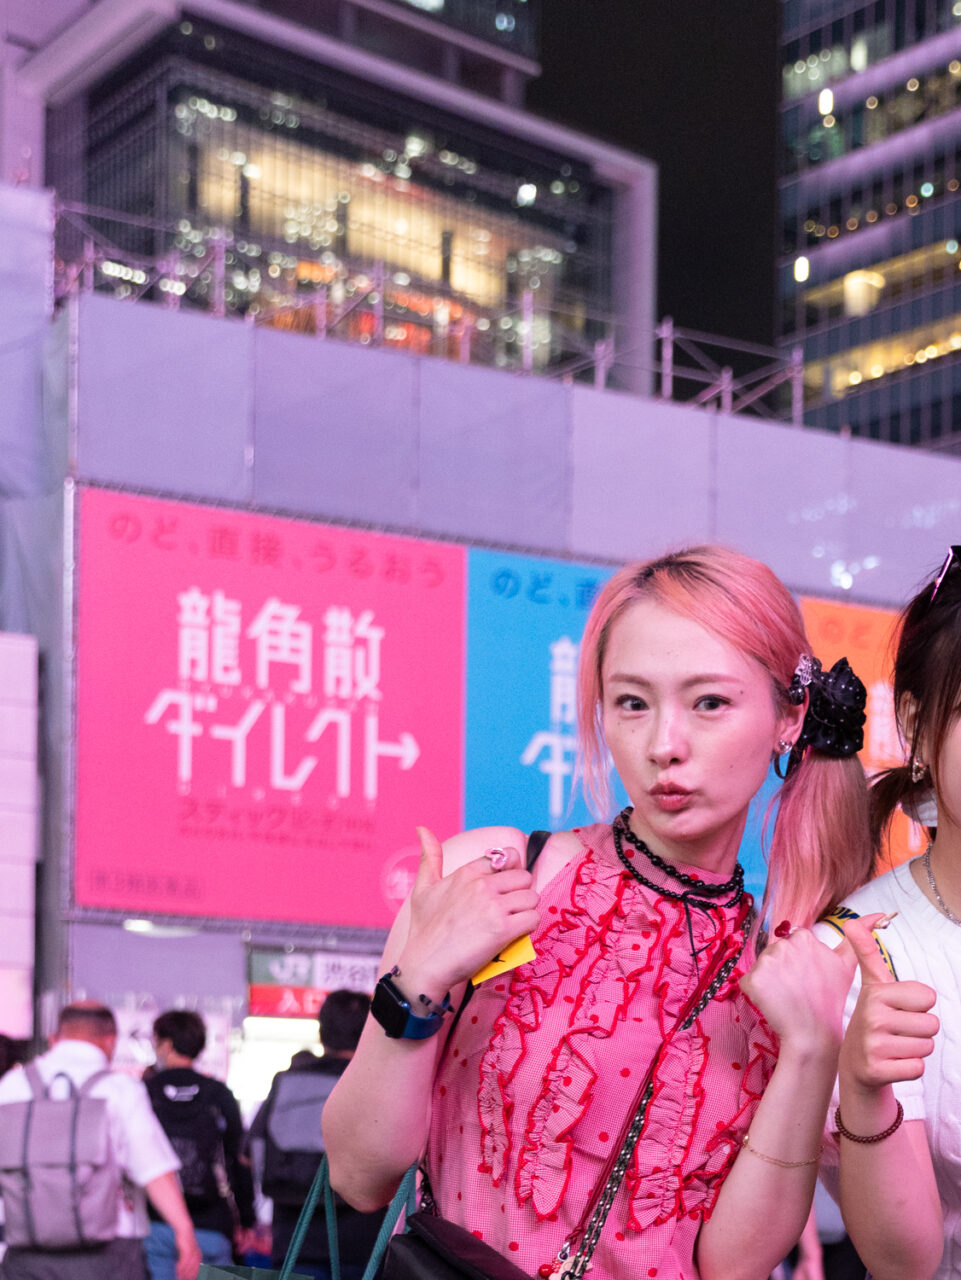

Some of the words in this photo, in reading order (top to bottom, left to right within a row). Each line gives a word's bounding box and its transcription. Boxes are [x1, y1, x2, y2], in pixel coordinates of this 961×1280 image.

[176, 586, 386, 699] 龍角散
[269, 954, 312, 984] JR
[324, 958, 380, 986] 渋谷
